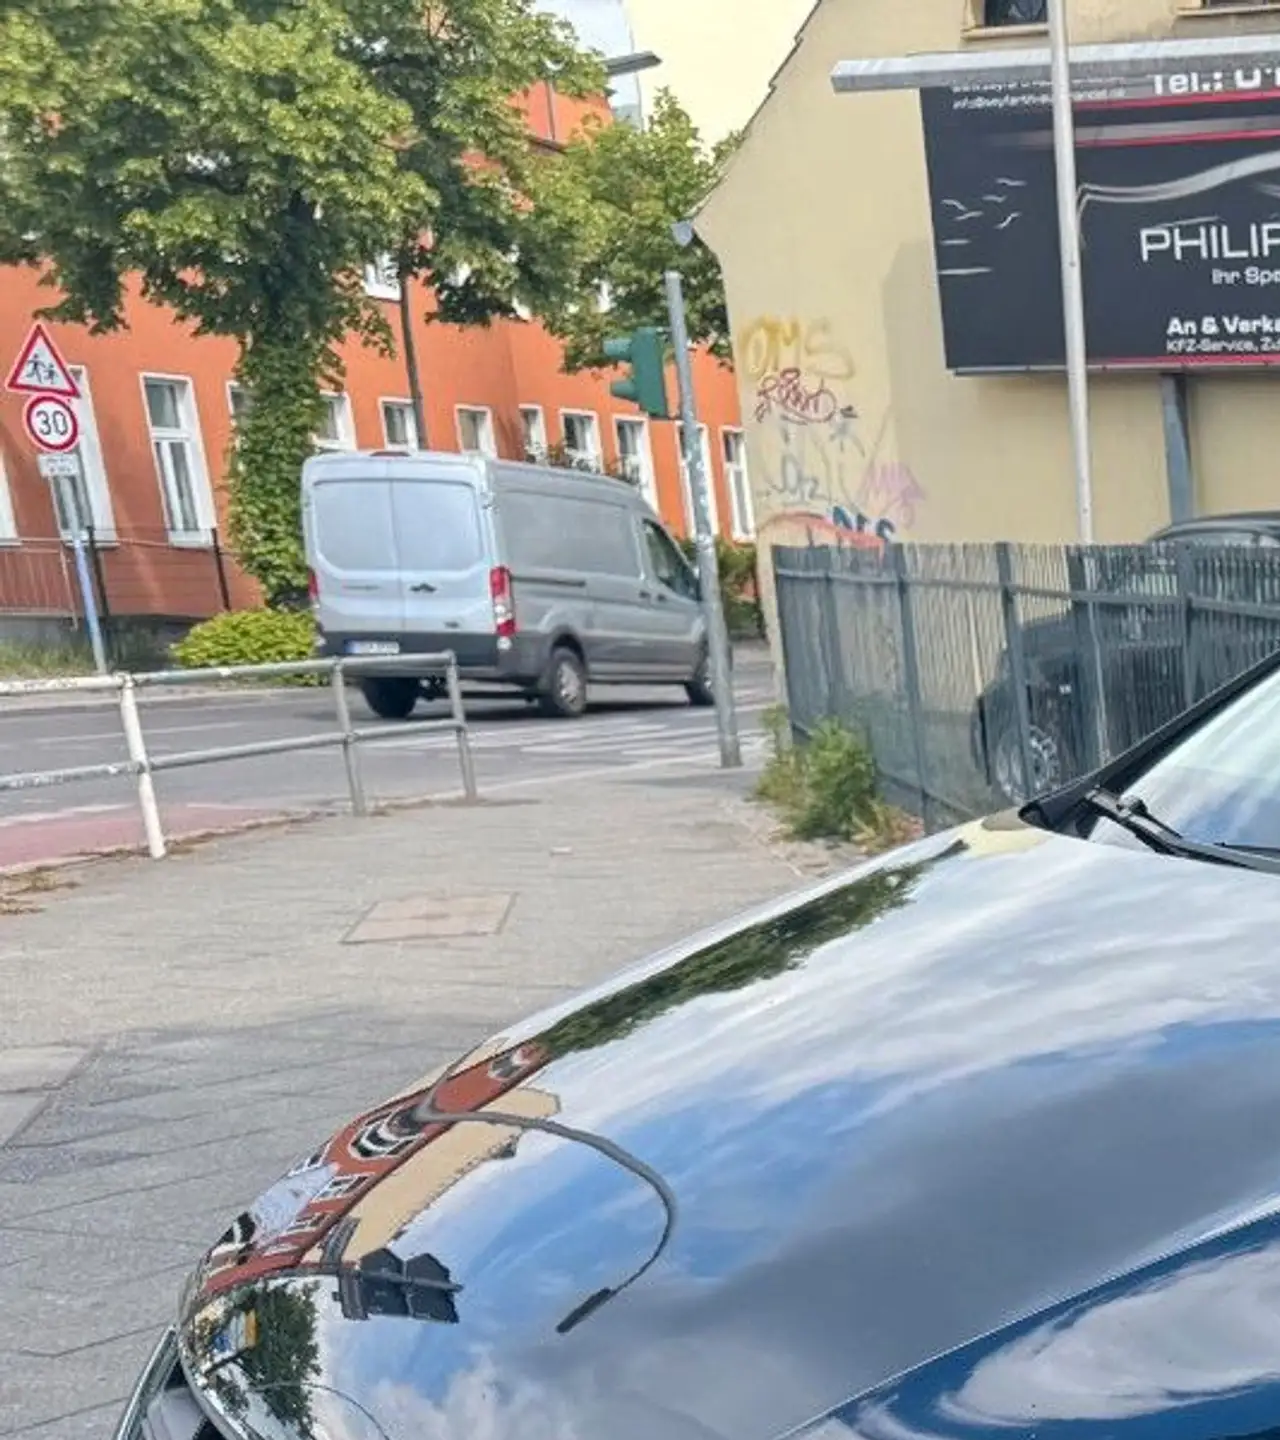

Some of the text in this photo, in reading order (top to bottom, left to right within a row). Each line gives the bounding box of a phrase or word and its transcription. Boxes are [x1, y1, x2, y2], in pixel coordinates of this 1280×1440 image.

[1212, 267, 1242, 284] Ihr
[1166, 316, 1198, 335] An
[1201, 315, 1220, 334] &
[36, 410, 69, 436] 30
